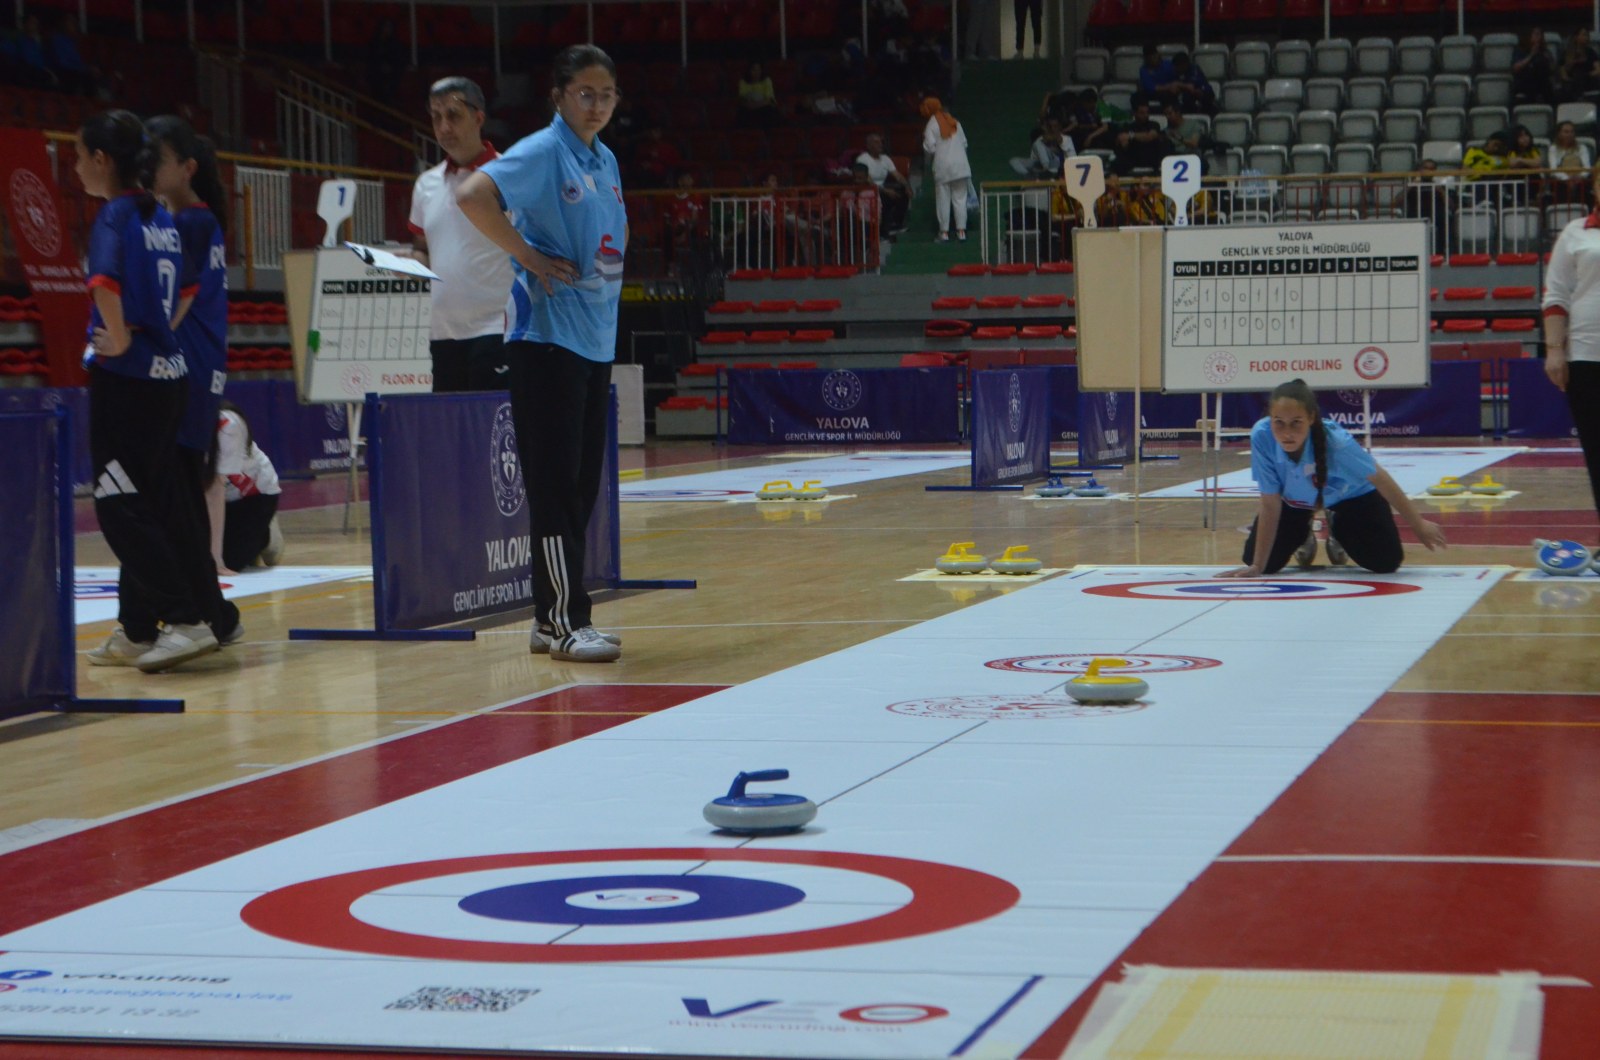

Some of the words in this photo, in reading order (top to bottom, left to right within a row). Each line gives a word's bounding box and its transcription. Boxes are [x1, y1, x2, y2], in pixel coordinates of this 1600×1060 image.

[1075, 163, 1091, 186] 7
[1173, 160, 1189, 183] 2
[336, 186, 347, 207] 1
[1278, 231, 1313, 241] YALOVA
[1221, 244, 1260, 257] GENÇLİK
[1262, 247, 1274, 256] VE
[1276, 246, 1300, 255] SPOR
[1302, 244, 1310, 255] İL
[1312, 242, 1371, 254] MÜDÜRLÜĞÜ
[1175, 265, 1197, 274] OYUN
[1205, 264, 1210, 272] 1
[1222, 264, 1228, 272] 2
[1239, 264, 1245, 272] 3
[1256, 263, 1263, 271] 4
[1273, 263, 1280, 271] 5
[1290, 262, 1297, 271] 6
[1307, 262, 1314, 270] 7
[1324, 261, 1331, 270] 8
[1342, 261, 1349, 270] 9
[1359, 261, 1368, 269] 10
[1375, 260, 1386, 269] EX
[1391, 260, 1417, 268] TOPLAM
[1221, 291, 1230, 302] 0
[1239, 293, 1247, 302] 0
[1289, 290, 1299, 302] 0
[1204, 318, 1212, 328] 0
[1238, 316, 1247, 327] 0
[1254, 317, 1264, 330] 0
[1271, 318, 1281, 331] 0
[1249, 360, 1288, 372] FLOOR
[1290, 358, 1342, 371] CURLING
[815, 416, 870, 429] YALOVA
[785, 431, 815, 442] GENÇLİK
[826, 432, 845, 440] SPOR
[855, 430, 901, 440] MÜDÜRLÜĞÜ
[485, 535, 531, 573] YALOVA
[453, 584, 486, 615] GENÇLİK
[486, 586, 495, 607] VE
[496, 582, 514, 605] SPOR
